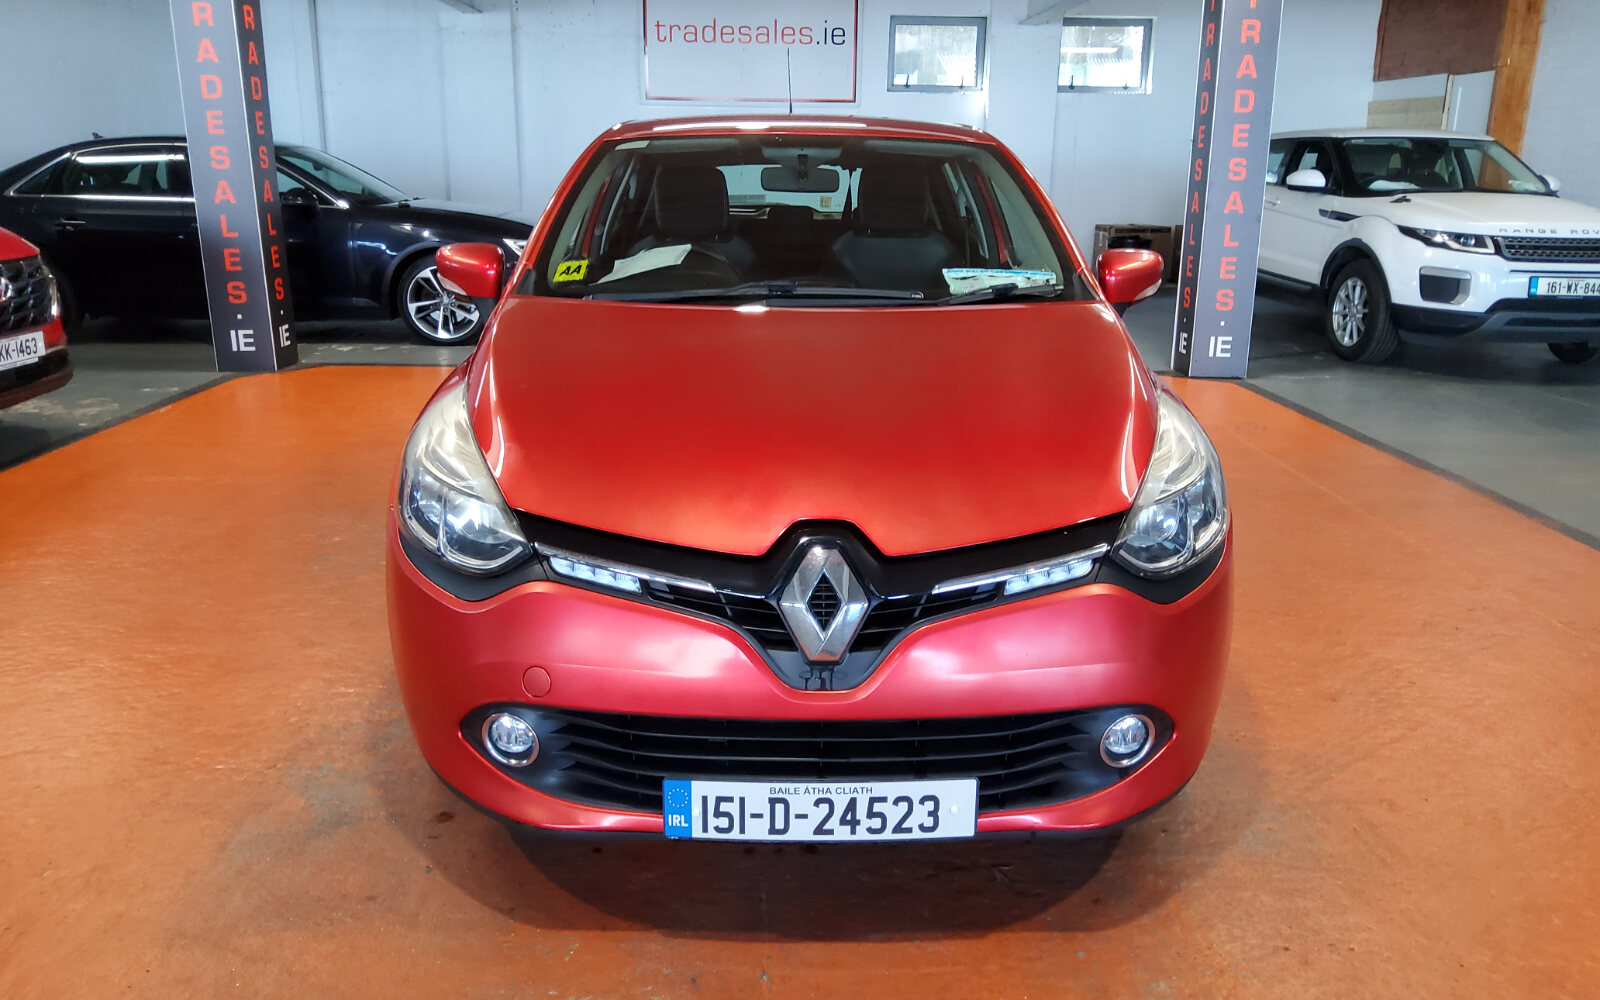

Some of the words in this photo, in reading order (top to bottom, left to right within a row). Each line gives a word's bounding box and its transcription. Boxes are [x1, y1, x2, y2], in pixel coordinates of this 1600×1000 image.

[654, 18, 846, 46] tradesales.ie
[560, 265, 583, 277] AA
[769, 786, 801, 795] BAILE
[803, 785, 832, 795] ÁTHA
[835, 786, 873, 795] CLIATH
[668, 814, 689, 827] IRL
[701, 795, 941, 836] 151-D-24523
